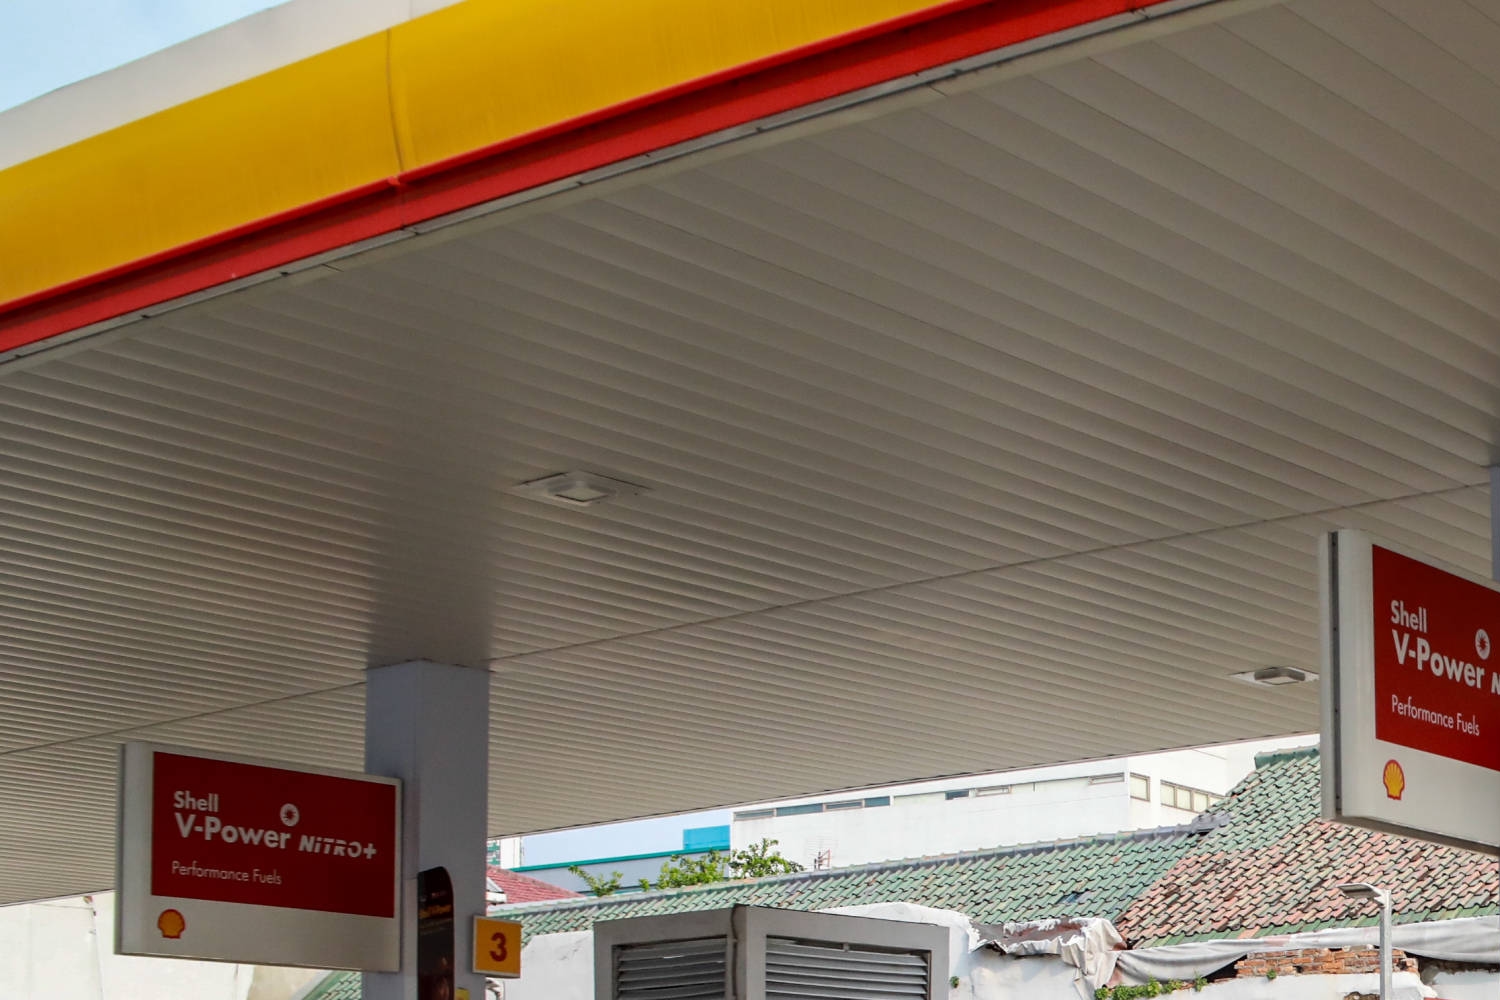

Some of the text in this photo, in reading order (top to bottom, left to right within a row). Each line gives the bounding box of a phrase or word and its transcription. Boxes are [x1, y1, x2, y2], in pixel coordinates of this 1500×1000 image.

[1391, 600, 1427, 633] Shell
[1391, 629, 1485, 689] V-Power
[1391, 694, 1480, 737] Performance Fuels
[174, 790, 219, 812] Shell
[175, 812, 291, 849] V-Power
[171, 860, 282, 885] Performance Fuels
[489, 932, 507, 962] 3
